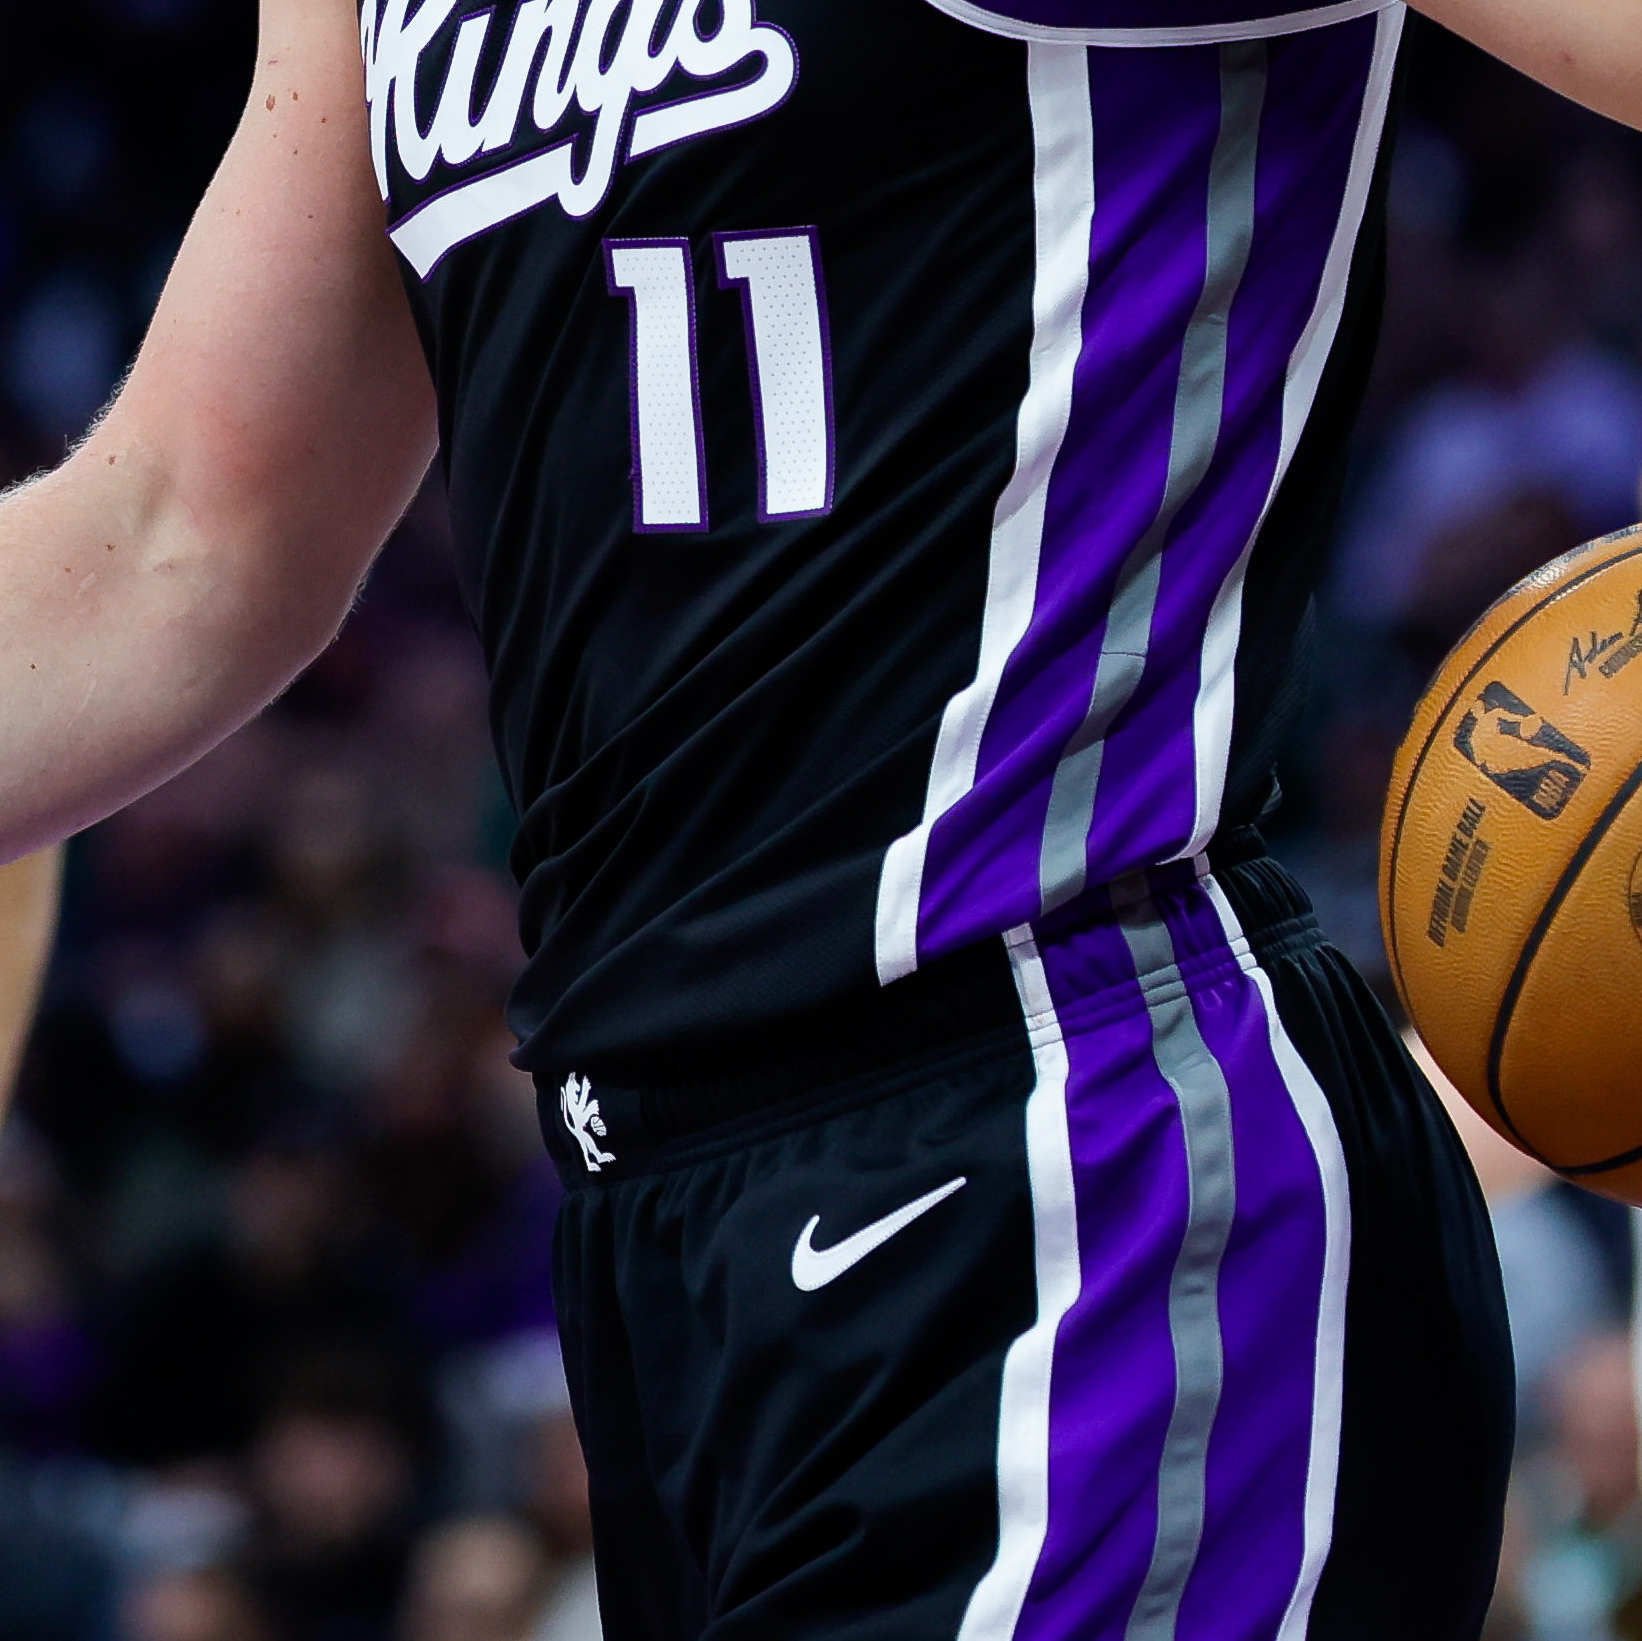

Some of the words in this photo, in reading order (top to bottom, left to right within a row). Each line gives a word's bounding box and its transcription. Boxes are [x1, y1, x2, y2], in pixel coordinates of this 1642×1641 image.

[602, 225, 836, 533] 11
[1532, 769, 1570, 808] NBA
[1442, 831, 1470, 882] GAME
[1457, 797, 1486, 839] BALL
